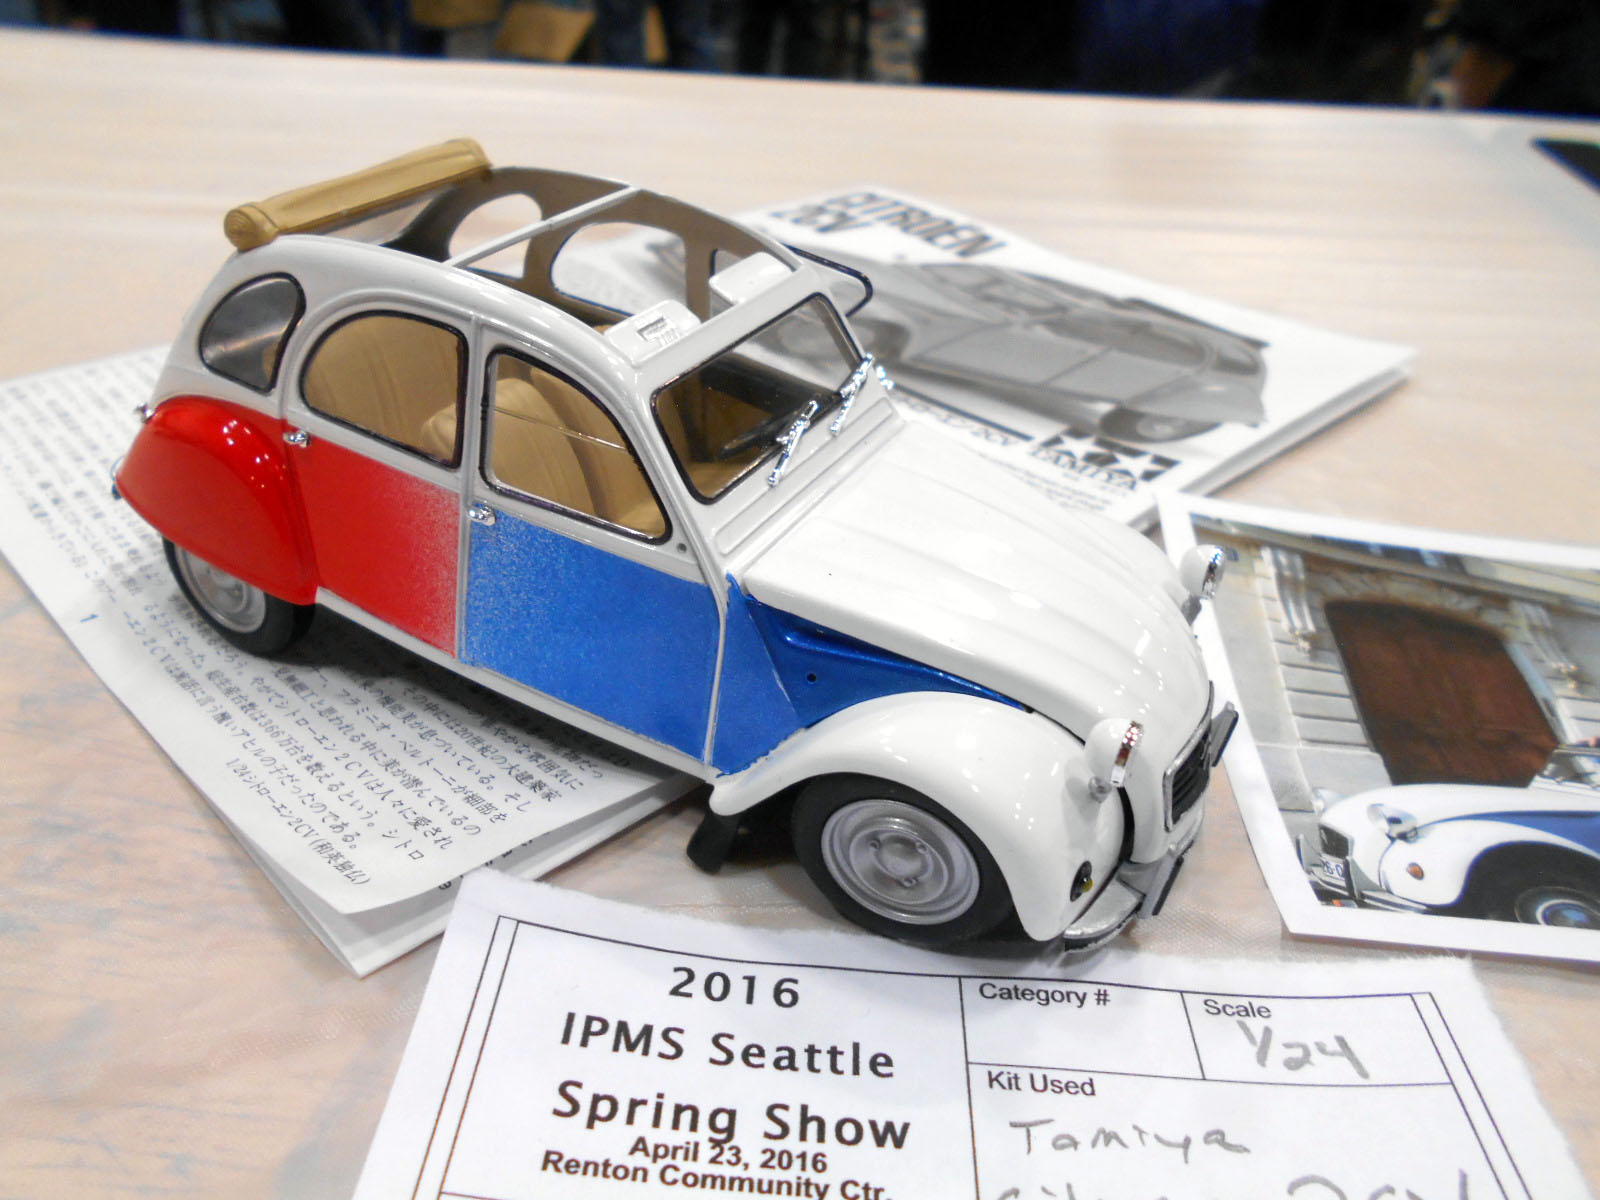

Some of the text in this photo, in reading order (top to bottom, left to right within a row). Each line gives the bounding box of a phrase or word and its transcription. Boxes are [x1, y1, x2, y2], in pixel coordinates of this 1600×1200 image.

[669, 966, 800, 1009] 2016
[978, 981, 1111, 1009] Category #
[1204, 999, 1272, 1019] Scale
[560, 1011, 895, 1078] IPMS Seattle
[988, 1071, 1096, 1097] Kit Used
[552, 1080, 911, 1150] Spring Show
[627, 1136, 828, 1173] April 23, 2016
[540, 1150, 649, 1183] Renton
[659, 1164, 830, 1200] Community
